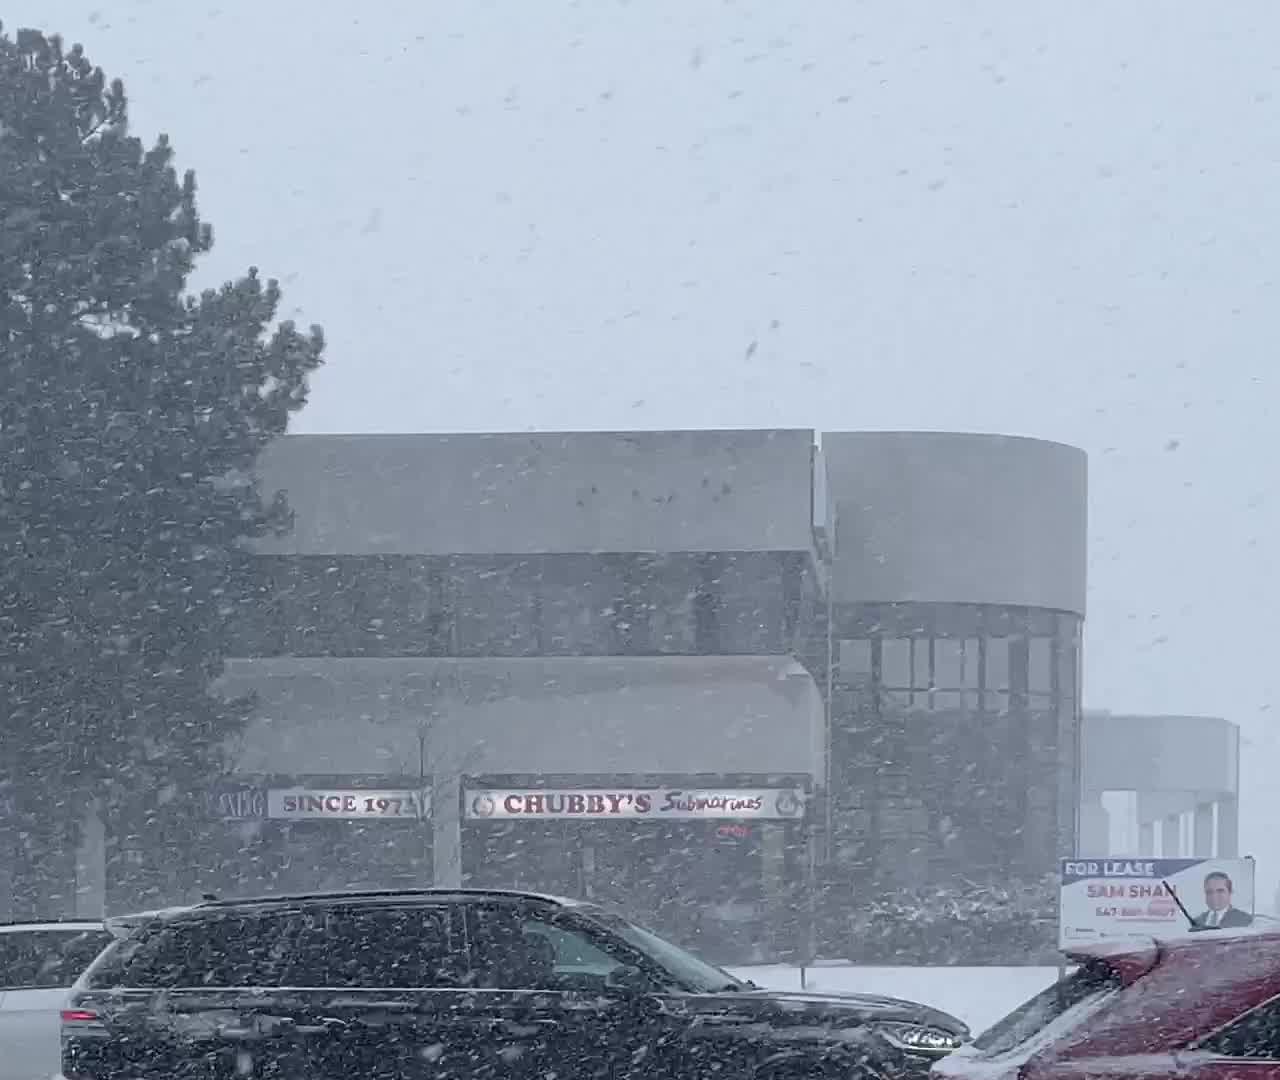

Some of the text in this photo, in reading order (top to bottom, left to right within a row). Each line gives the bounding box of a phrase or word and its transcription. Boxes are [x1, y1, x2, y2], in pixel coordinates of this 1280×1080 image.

[283, 795, 357, 813] SINCE
[504, 791, 763, 814] CHUBBY'S Submarines
[1064, 862, 1155, 877] FOR LEASE
